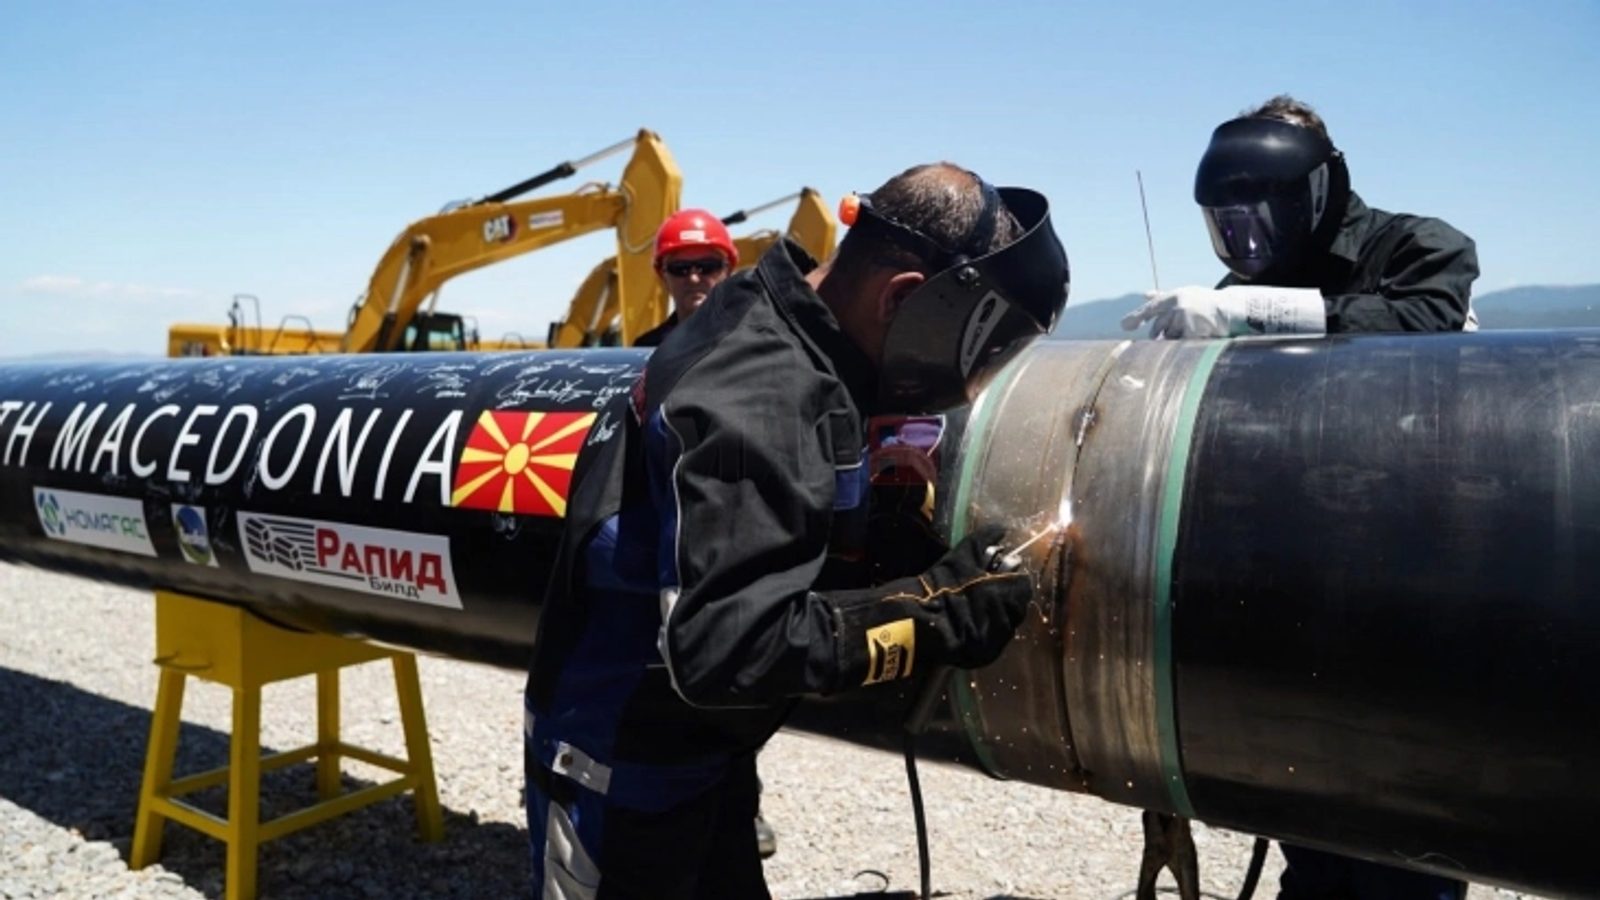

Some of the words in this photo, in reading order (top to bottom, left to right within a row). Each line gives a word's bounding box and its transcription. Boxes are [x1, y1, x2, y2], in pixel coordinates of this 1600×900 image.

[484, 213, 510, 243] CAT
[0, 400, 52, 467] TH
[49, 401, 464, 507] MACEDONIA
